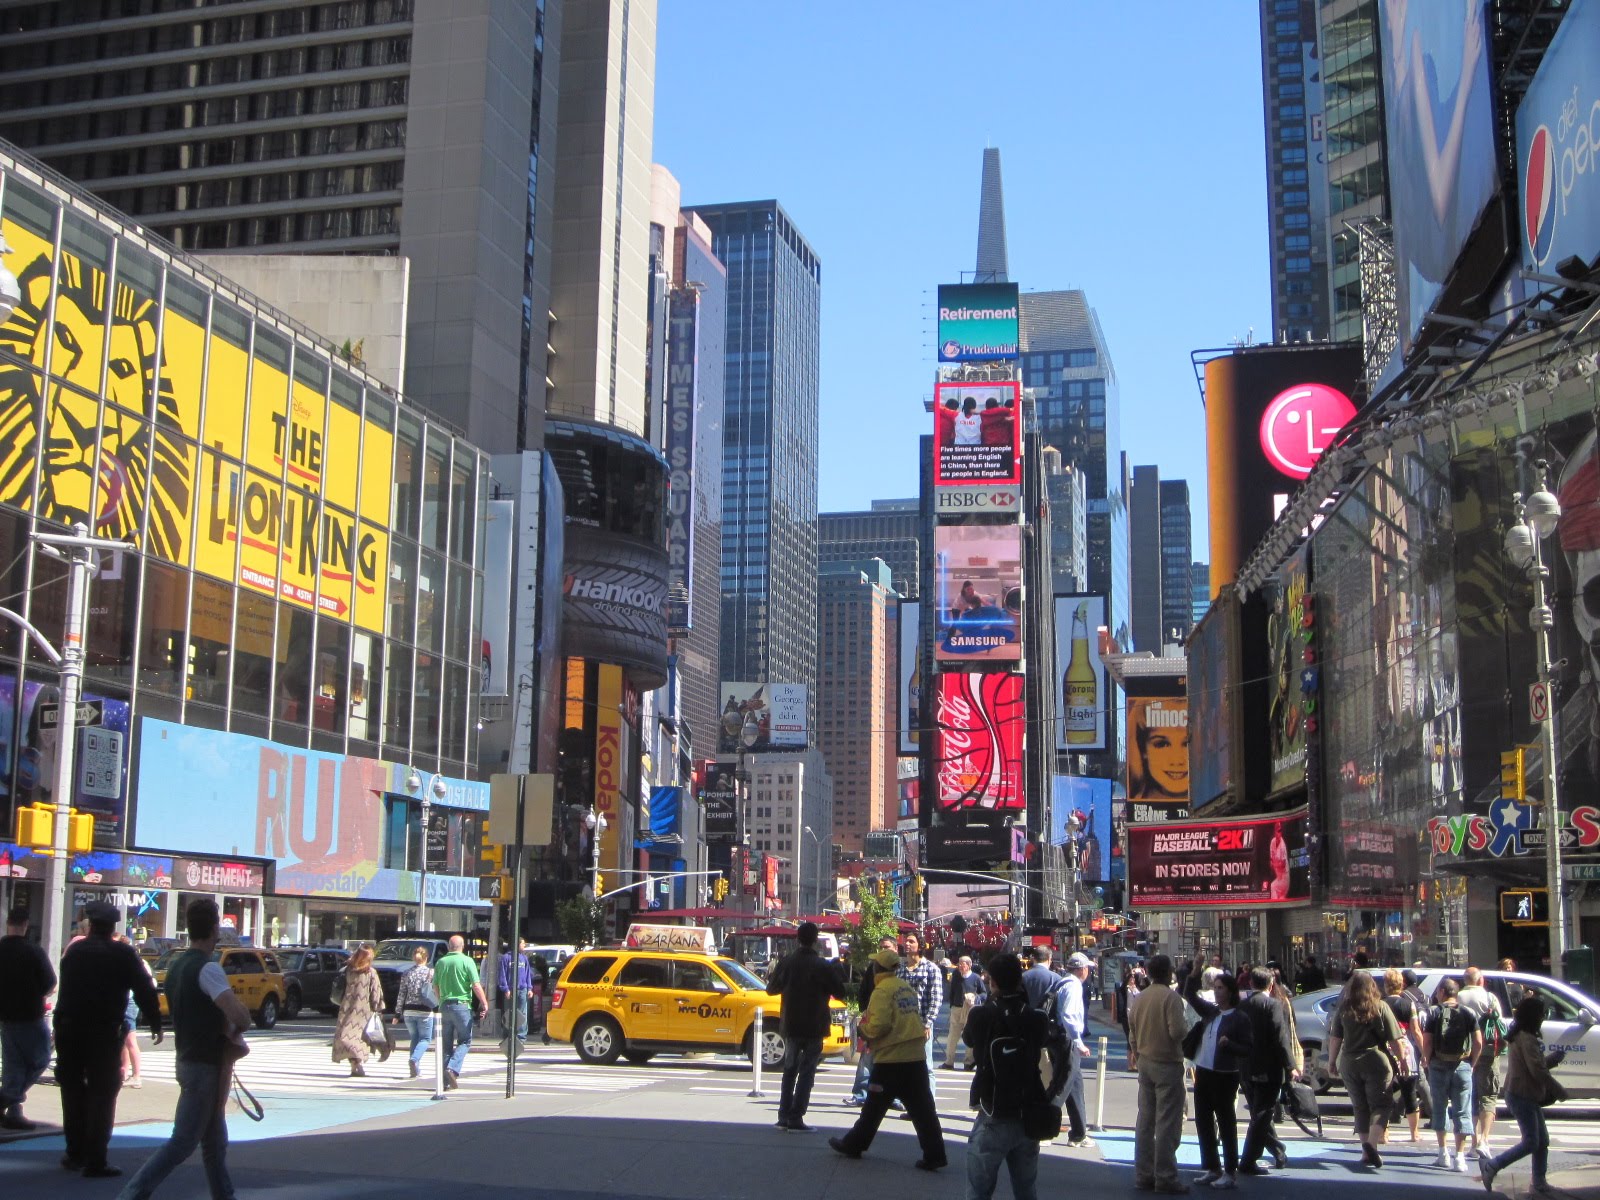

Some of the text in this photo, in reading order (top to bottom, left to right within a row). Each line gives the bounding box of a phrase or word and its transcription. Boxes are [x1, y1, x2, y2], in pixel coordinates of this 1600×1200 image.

[1558, 84, 1578, 142] diet
[939, 307, 1017, 320] Retirement
[962, 344, 1017, 355] Prudential
[670, 318, 693, 432] TIMES
[272, 411, 322, 473] THE
[990, 445, 1012, 453] people
[978, 453, 1002, 461] English
[951, 470, 973, 478] people
[981, 469, 1009, 478] England.
[939, 492, 988, 507] HSBC
[209, 440, 376, 582] LION KING
[668, 447, 690, 589] SQUARE
[242, 568, 338, 611] ENTRANCE ON 45TH STREET
[593, 601, 631, 615] driving
[950, 636, 1006, 647] SAMSUNG
[784, 687, 793, 696] By
[1066, 684, 1095, 696] Corona
[774, 695, 803, 705] George,
[76, 710, 93, 721] WAY
[778, 711, 790, 720] did
[1068, 707, 1094, 721] Light
[1145, 705, 1188, 728] Innoc
[597, 725, 619, 833] Kodak
[1154, 831, 1210, 842] MAJOR LEAGUE
[1428, 814, 1487, 857] TOYS
[1528, 835, 1546, 843] ONE
[1153, 840, 1211, 853] BASEBALL
[202, 865, 252, 888] ELEMENT
[1155, 861, 1251, 879] IN STORES NOW
[1574, 866, 1581, 878] W
[1583, 866, 1594, 878] 44
[645, 928, 700, 949] ZARKANA
[678, 1006, 697, 1014] NYC
[1548, 1044, 1587, 1053] CHASE
